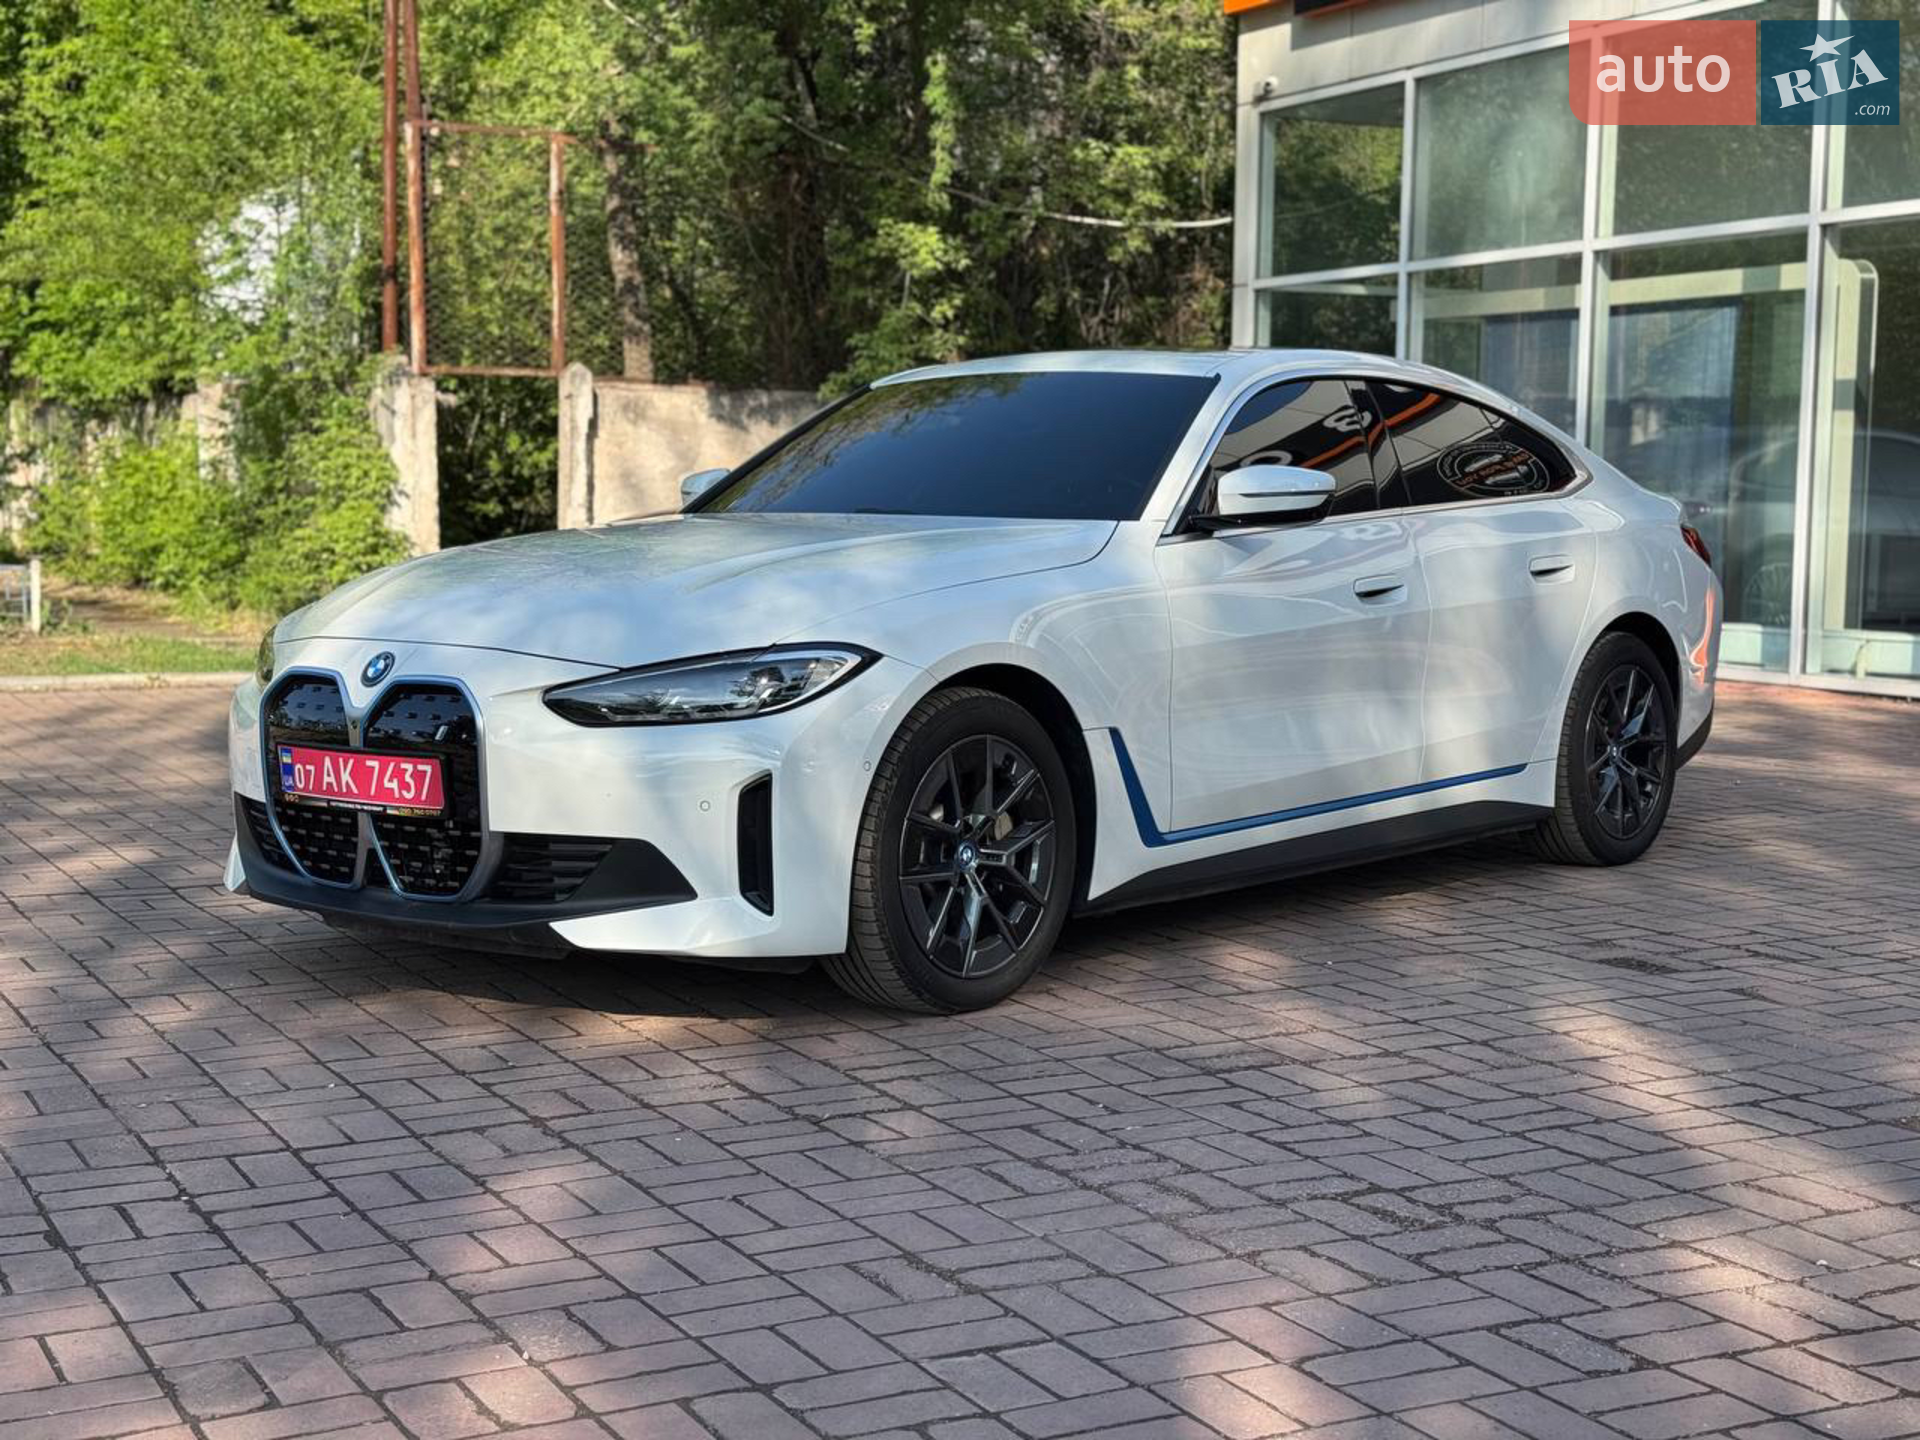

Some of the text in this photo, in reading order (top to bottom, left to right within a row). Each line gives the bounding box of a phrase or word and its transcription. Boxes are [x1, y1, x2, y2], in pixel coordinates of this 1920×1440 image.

[294, 756, 432, 801] 07 AK 7437
